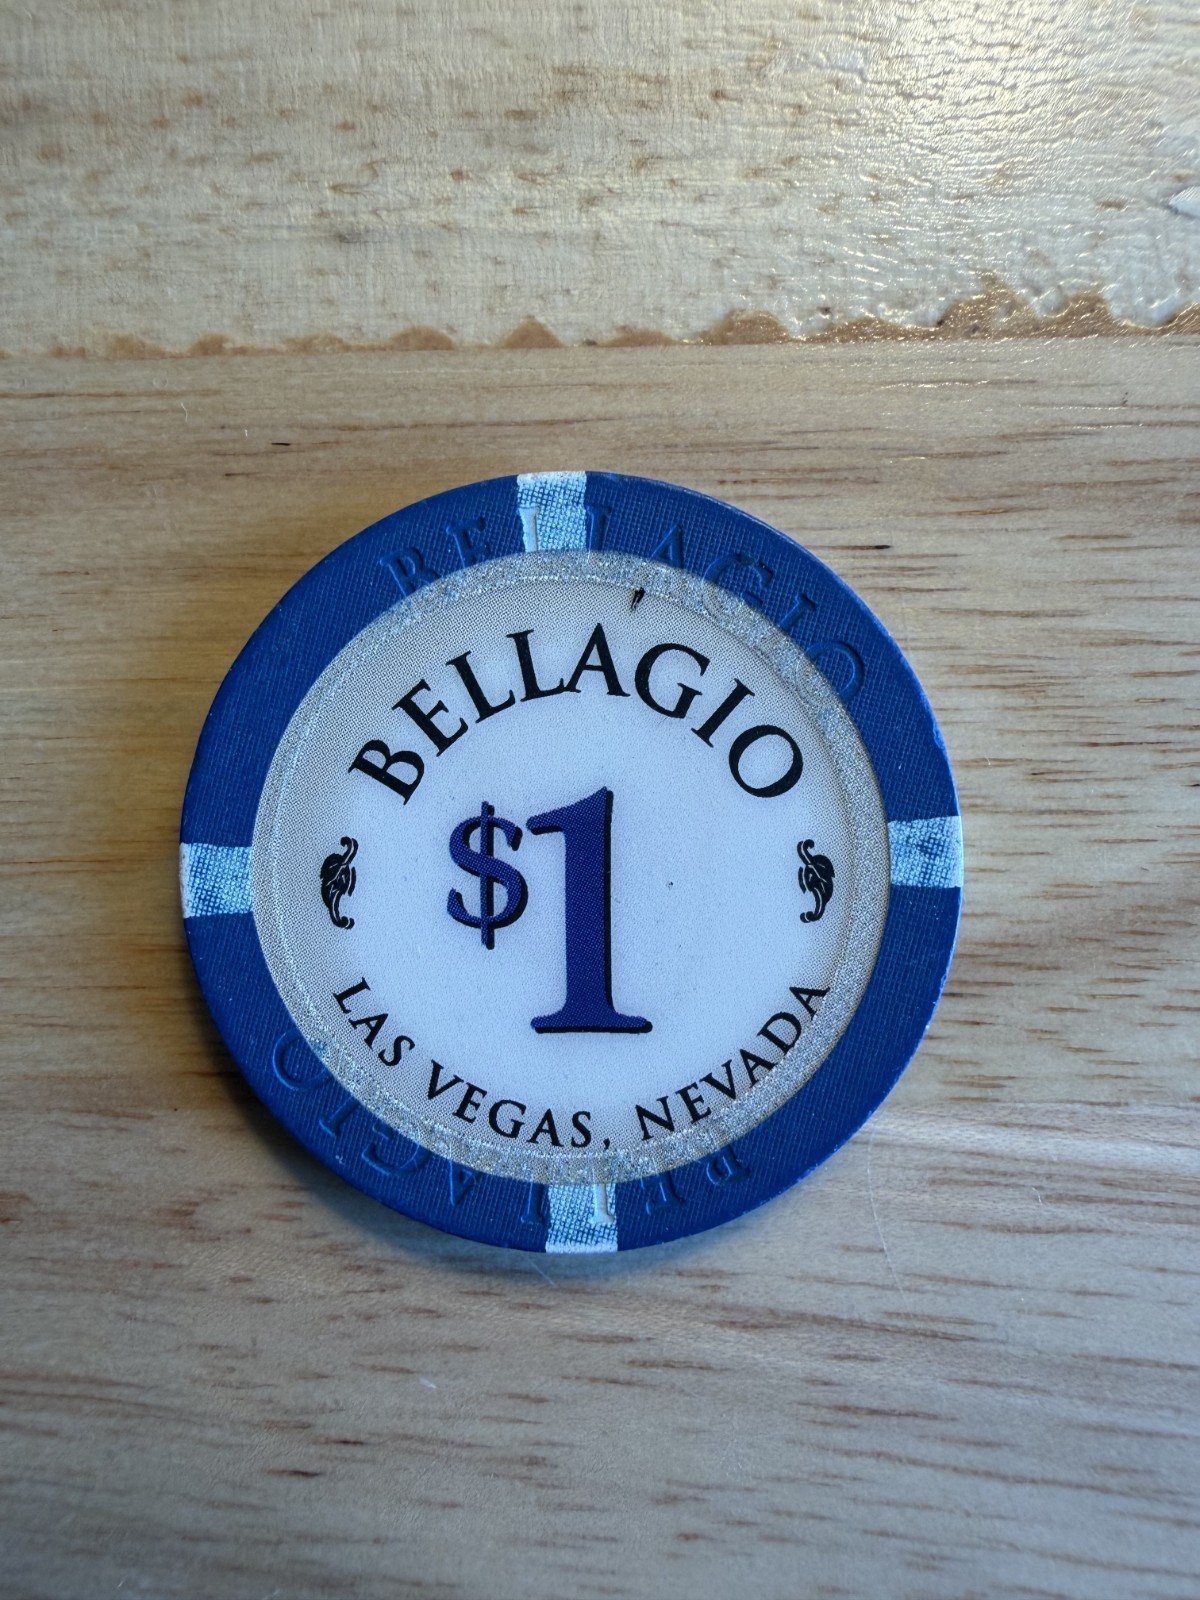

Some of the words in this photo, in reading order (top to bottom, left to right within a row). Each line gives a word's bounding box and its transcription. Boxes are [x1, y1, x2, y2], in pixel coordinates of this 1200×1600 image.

[348, 622, 804, 805] BELLAGIO
[446, 786, 653, 1034] $1
[333, 977, 415, 1067] LAS
[426, 1059, 611, 1150] VEGAS,
[635, 983, 831, 1142] NEVADA
